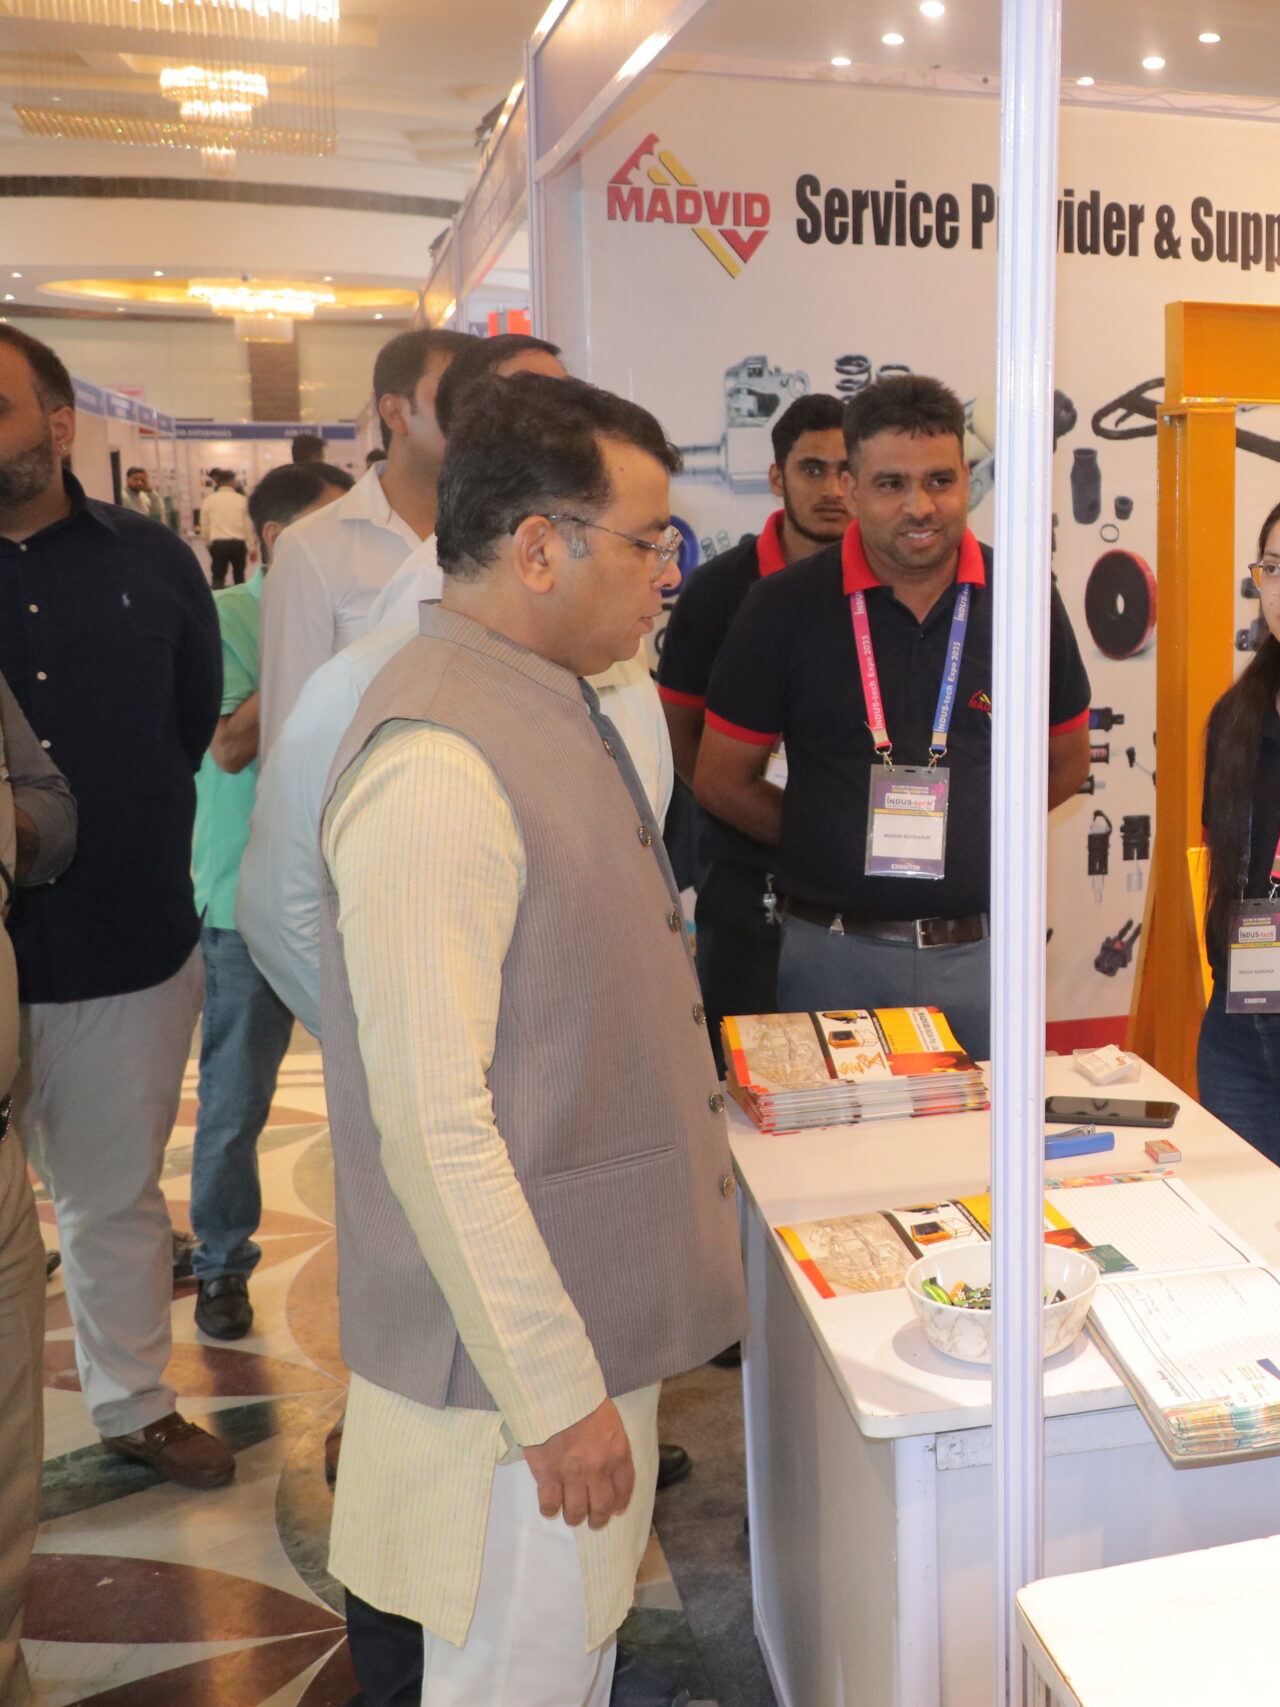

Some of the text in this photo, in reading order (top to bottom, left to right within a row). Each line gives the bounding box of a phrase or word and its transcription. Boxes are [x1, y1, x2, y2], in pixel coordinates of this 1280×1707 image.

[607, 183, 770, 227] MADVID
[796, 173, 959, 249] Service
[971, 183, 1145, 258] Pider
[1154, 204, 1181, 260] &
